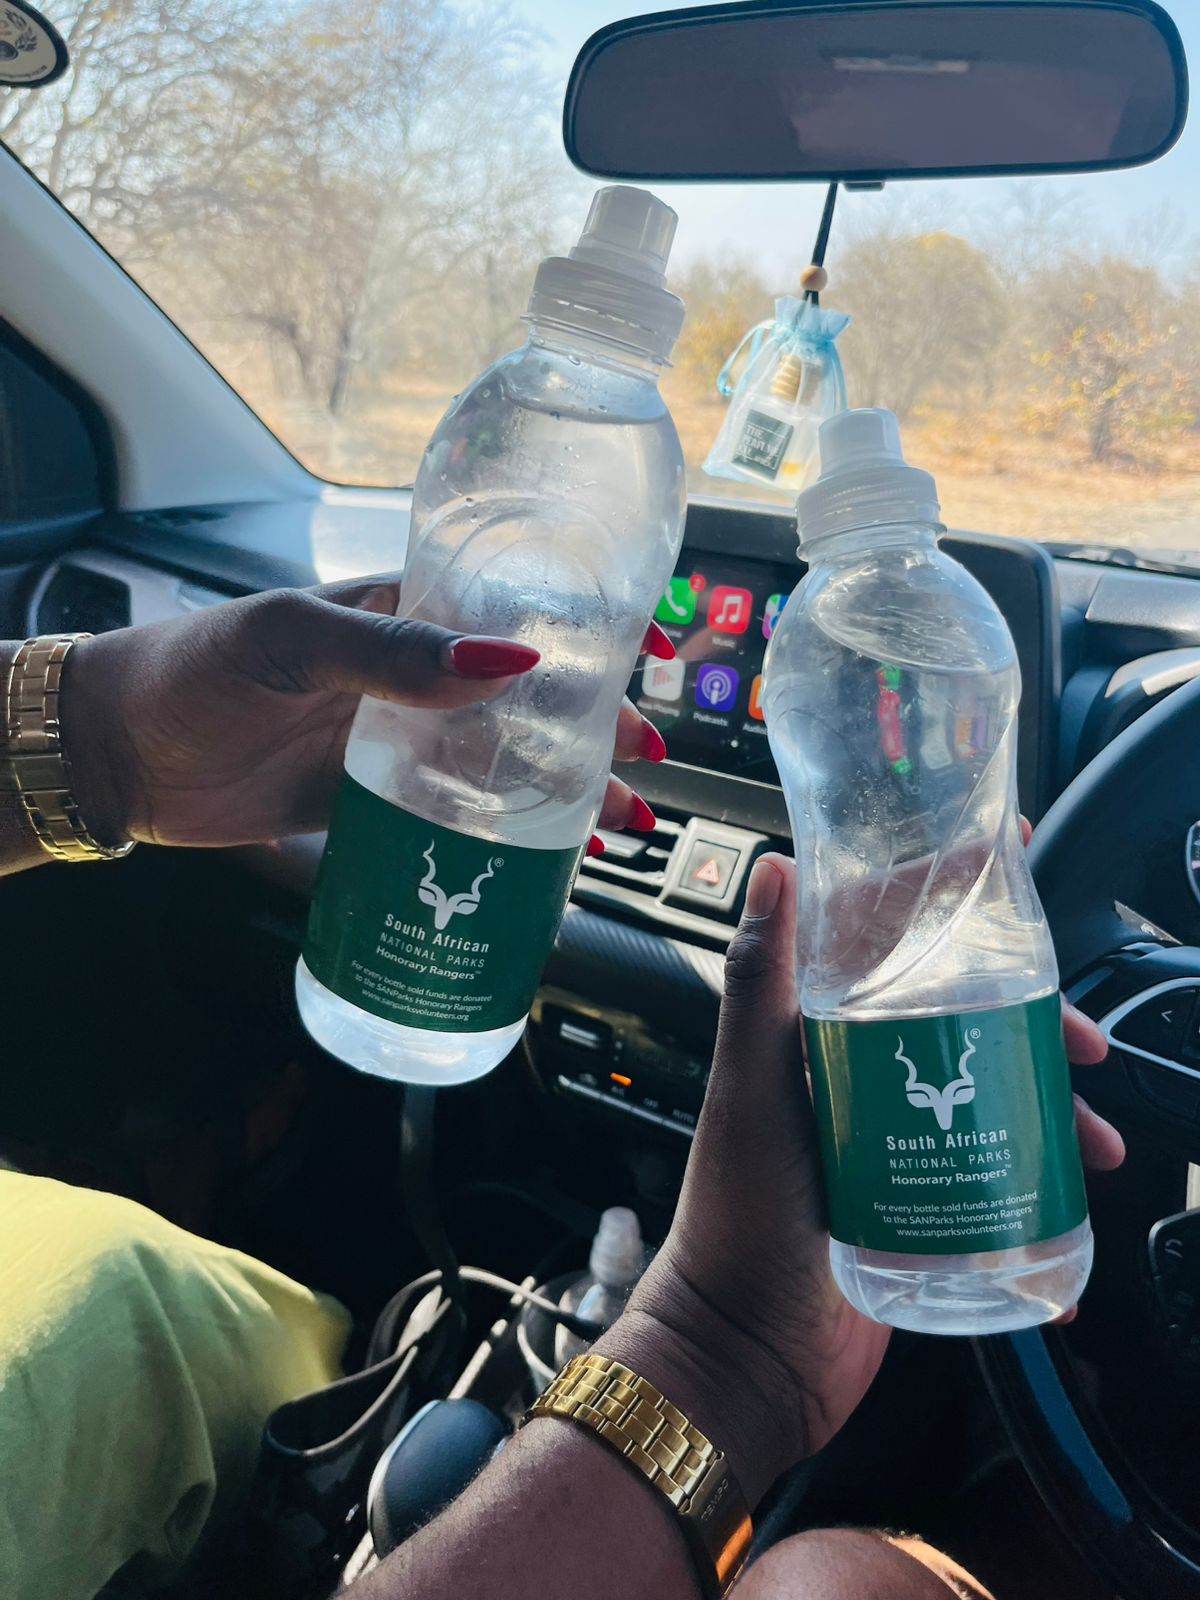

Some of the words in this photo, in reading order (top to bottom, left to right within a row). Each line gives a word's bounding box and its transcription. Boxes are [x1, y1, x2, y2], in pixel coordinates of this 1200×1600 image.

[712, 637, 735, 649] Music
[693, 711, 728, 727] Podcasts
[385, 913, 426, 941] South
[432, 933, 490, 953] African
[376, 945, 428, 973] Honorary
[380, 932, 437, 961] NATIONAL
[446, 954, 486, 968] PARKS
[351, 959, 363, 971] For
[363, 968, 383, 981] every
[383, 977, 407, 990] bottle
[407, 986, 425, 996] sold
[425, 989, 448, 1000] funds
[462, 994, 493, 1002] donated
[354, 973, 363, 982] to
[363, 977, 376, 988] the
[415, 997, 453, 1011] Honorary
[453, 1003, 482, 1013] Rangers
[361, 988, 470, 1021] www.sanparksvolunteers.org
[886, 1135, 936, 1151] South
[945, 1128, 1009, 1149] African
[889, 1156, 958, 1169] NATIONAL
[968, 1148, 1012, 1165] PARKS
[891, 1175, 953, 1187] Honorary
[873, 1201, 887, 1211] For
[888, 1204, 912, 1215] every
[913, 1203, 940, 1213] bottle
[942, 1202, 961, 1212] sold
[963, 1200, 989, 1211] funds
[990, 1199, 1004, 1208] are
[1005, 1189, 1038, 1205] donated
[882, 1215, 892, 1223] to
[893, 1215, 908, 1224] the
[909, 1215, 954, 1225] SANParks
[956, 1212, 999, 1224] Honorary
[1000, 1205, 1033, 1219] Rangers
[896, 1220, 1023, 1238] www.sanparksvolunteers.org
